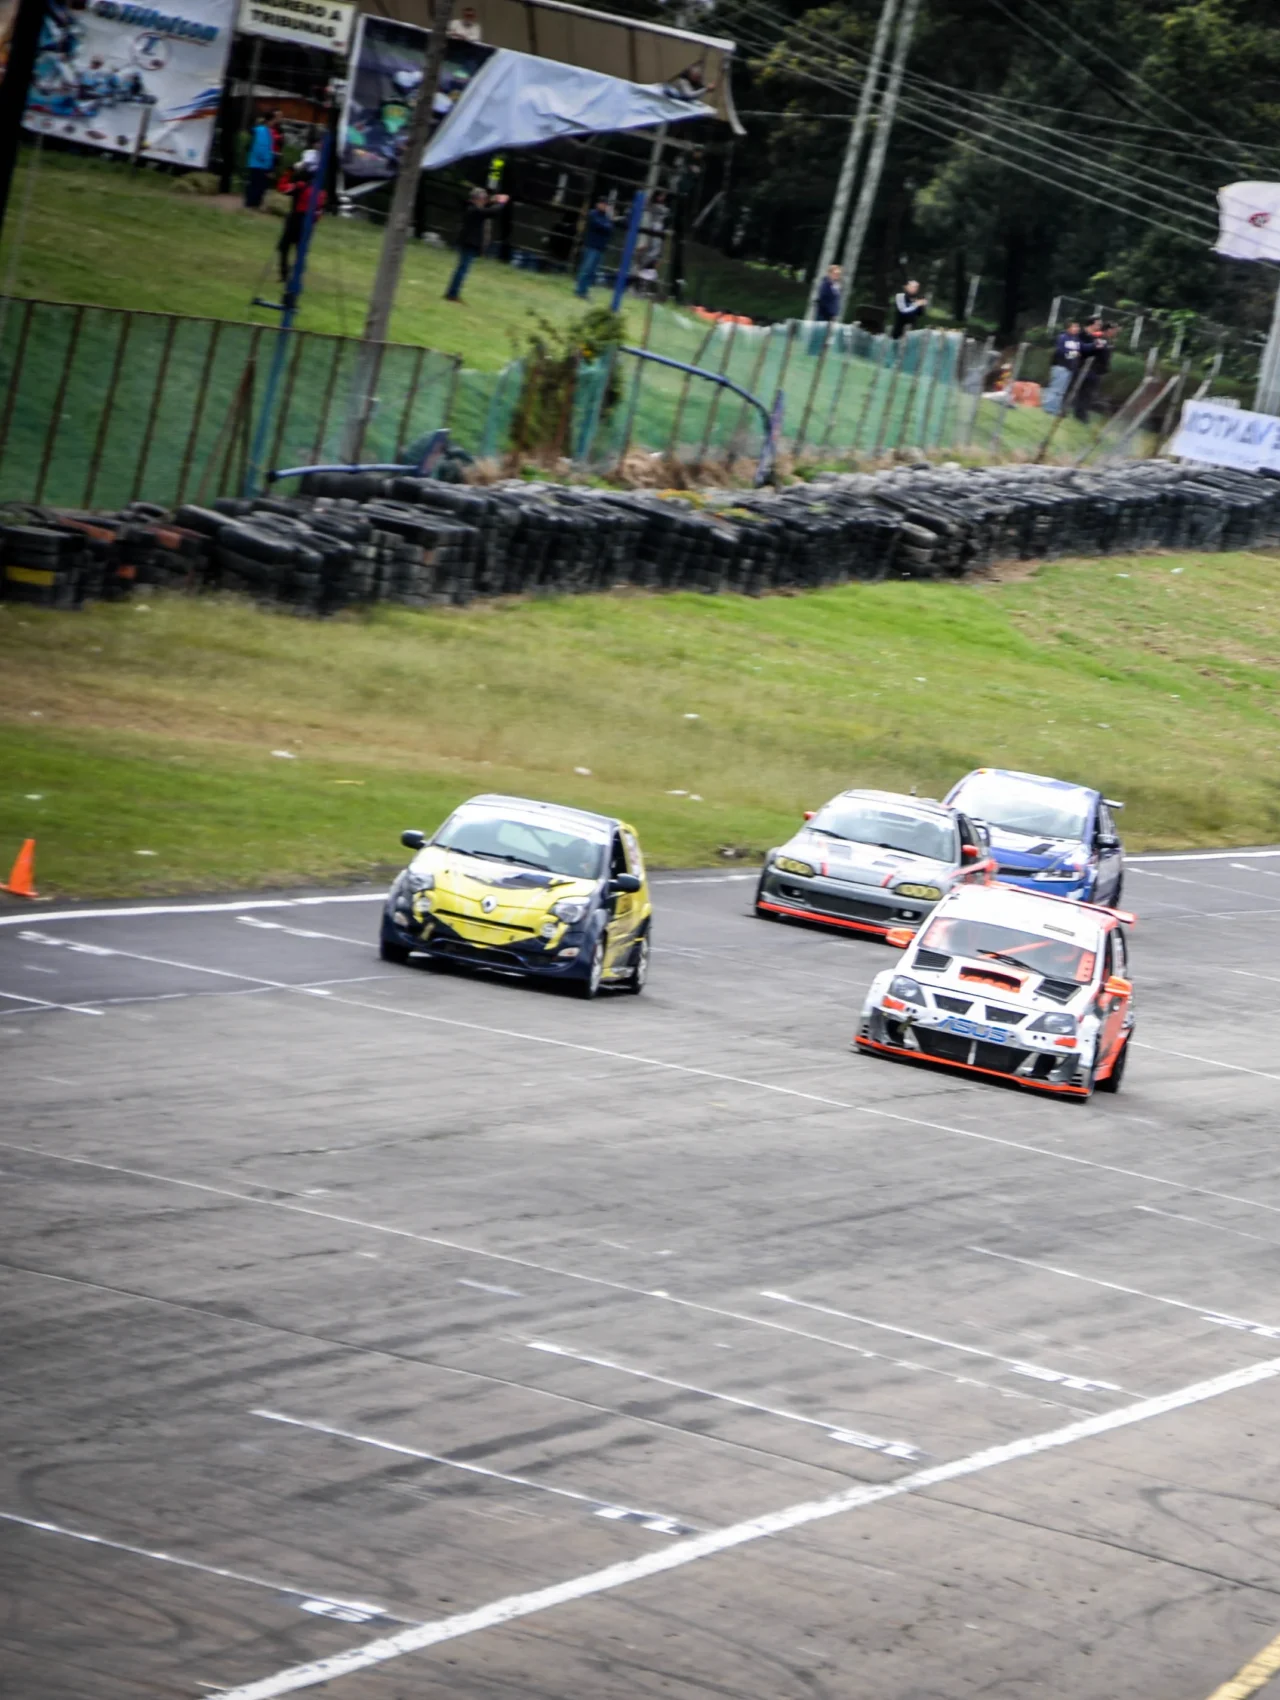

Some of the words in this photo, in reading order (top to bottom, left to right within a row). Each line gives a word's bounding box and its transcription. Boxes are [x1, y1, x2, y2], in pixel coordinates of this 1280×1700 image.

[249, 0, 327, 18] GRESO
[330, 9, 342, 22] A
[251, 8, 336, 38] TRIBUNAS
[937, 1015, 1007, 1043] ASUS
